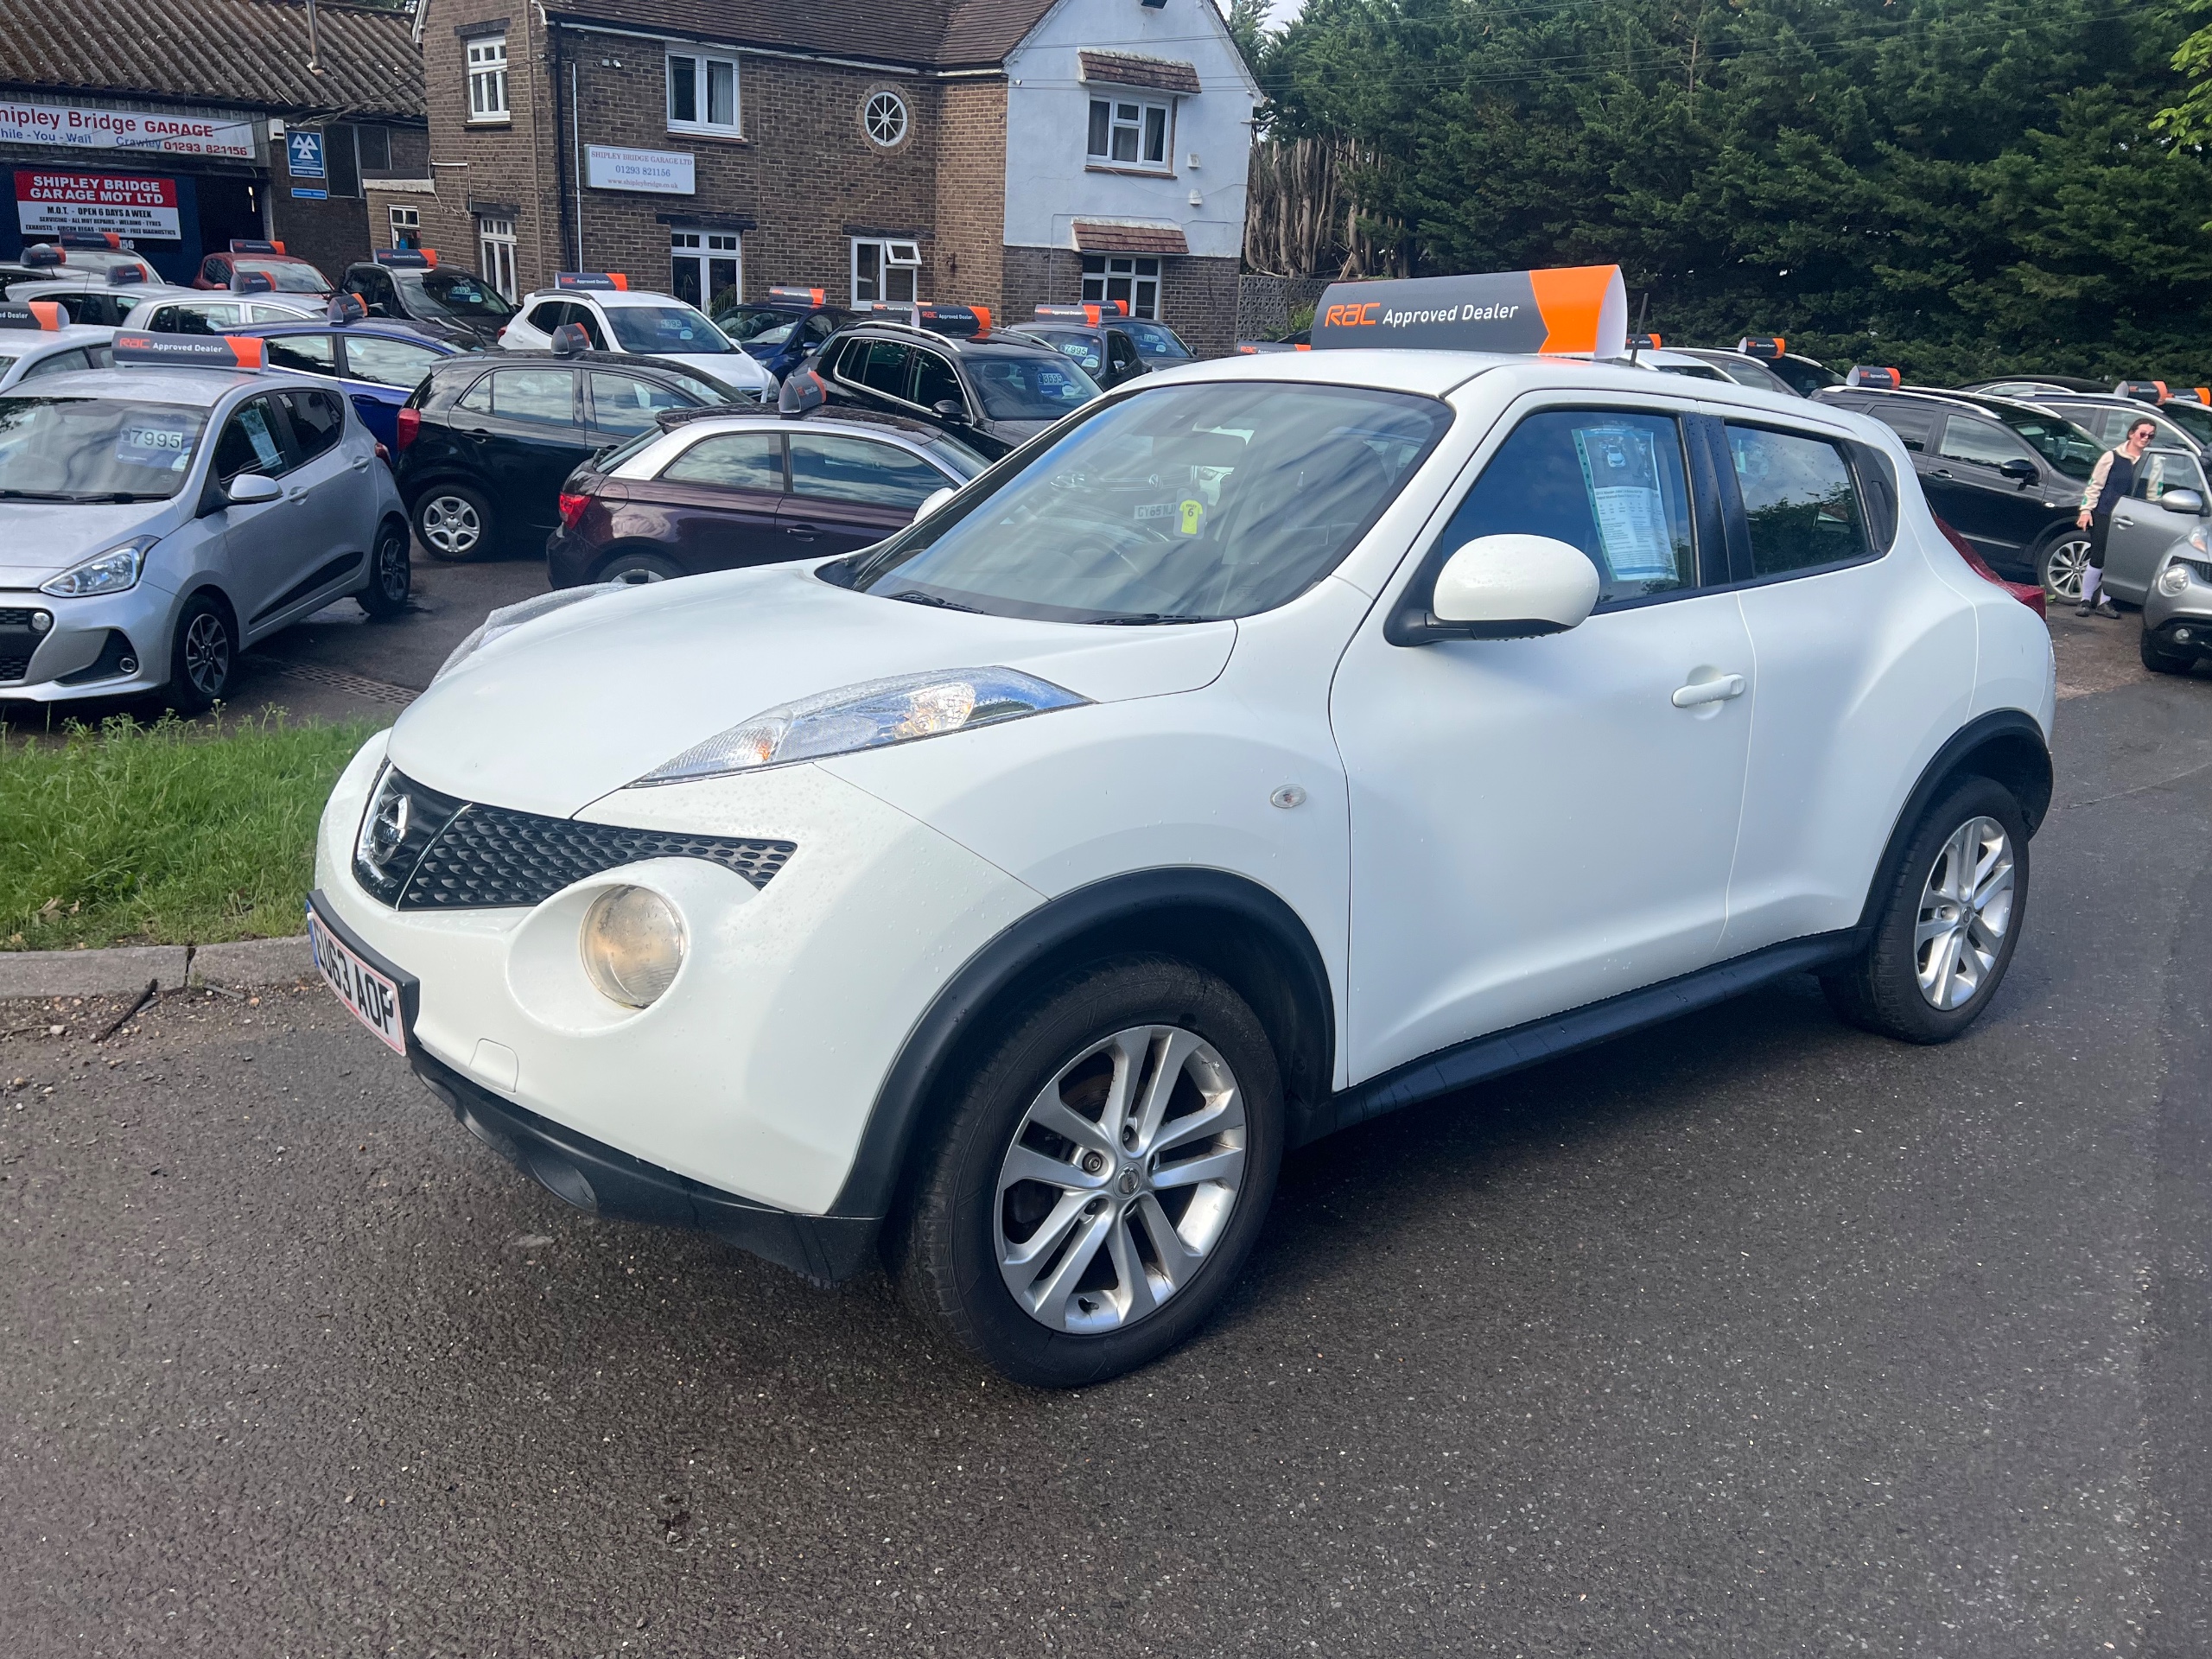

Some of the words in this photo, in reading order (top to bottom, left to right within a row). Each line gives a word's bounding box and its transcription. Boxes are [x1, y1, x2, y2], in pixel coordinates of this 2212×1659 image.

[0, 106, 60, 130] hipley
[68, 111, 137, 135] Bridge
[144, 121, 213, 137] GARAGE
[1, 128, 23, 139] hile
[33, 130, 55, 142] You
[66, 132, 92, 144] Wait
[116, 136, 162, 150] Crawley
[164, 141, 200, 153] 01293
[206, 144, 247, 156] 821156
[591, 150, 622, 160] SHIPLEY
[622, 153, 650, 162] BRIDGE
[650, 156, 679, 165] GARAGE
[615, 164, 640, 175] 01293
[642, 167, 671, 177] 821156
[33, 175, 99, 189] SHIPLEY
[104, 179, 161, 193] BRIDGE
[30, 188, 96, 201] GARAGE
[100, 191, 132, 202] MOT
[137, 193, 164, 205] LTD
[47, 206, 69, 215] M.O.T.
[78, 207, 97, 216] OPEN
[105, 208, 124, 217] DAYS
[131, 209, 152, 218] WEEK
[7, 311, 29, 320] Dealer
[1324, 302, 1381, 327] RAC
[1382, 305, 1458, 328] Approved
[1460, 302, 1519, 321] Dealer
[118, 337, 150, 348] RAC
[152, 342, 193, 353] Approved
[194, 344, 223, 353] Dealer
[1187, 508, 1194, 517] 6
[314, 918, 352, 1001] EU63
[354, 963, 394, 1035] AOP
